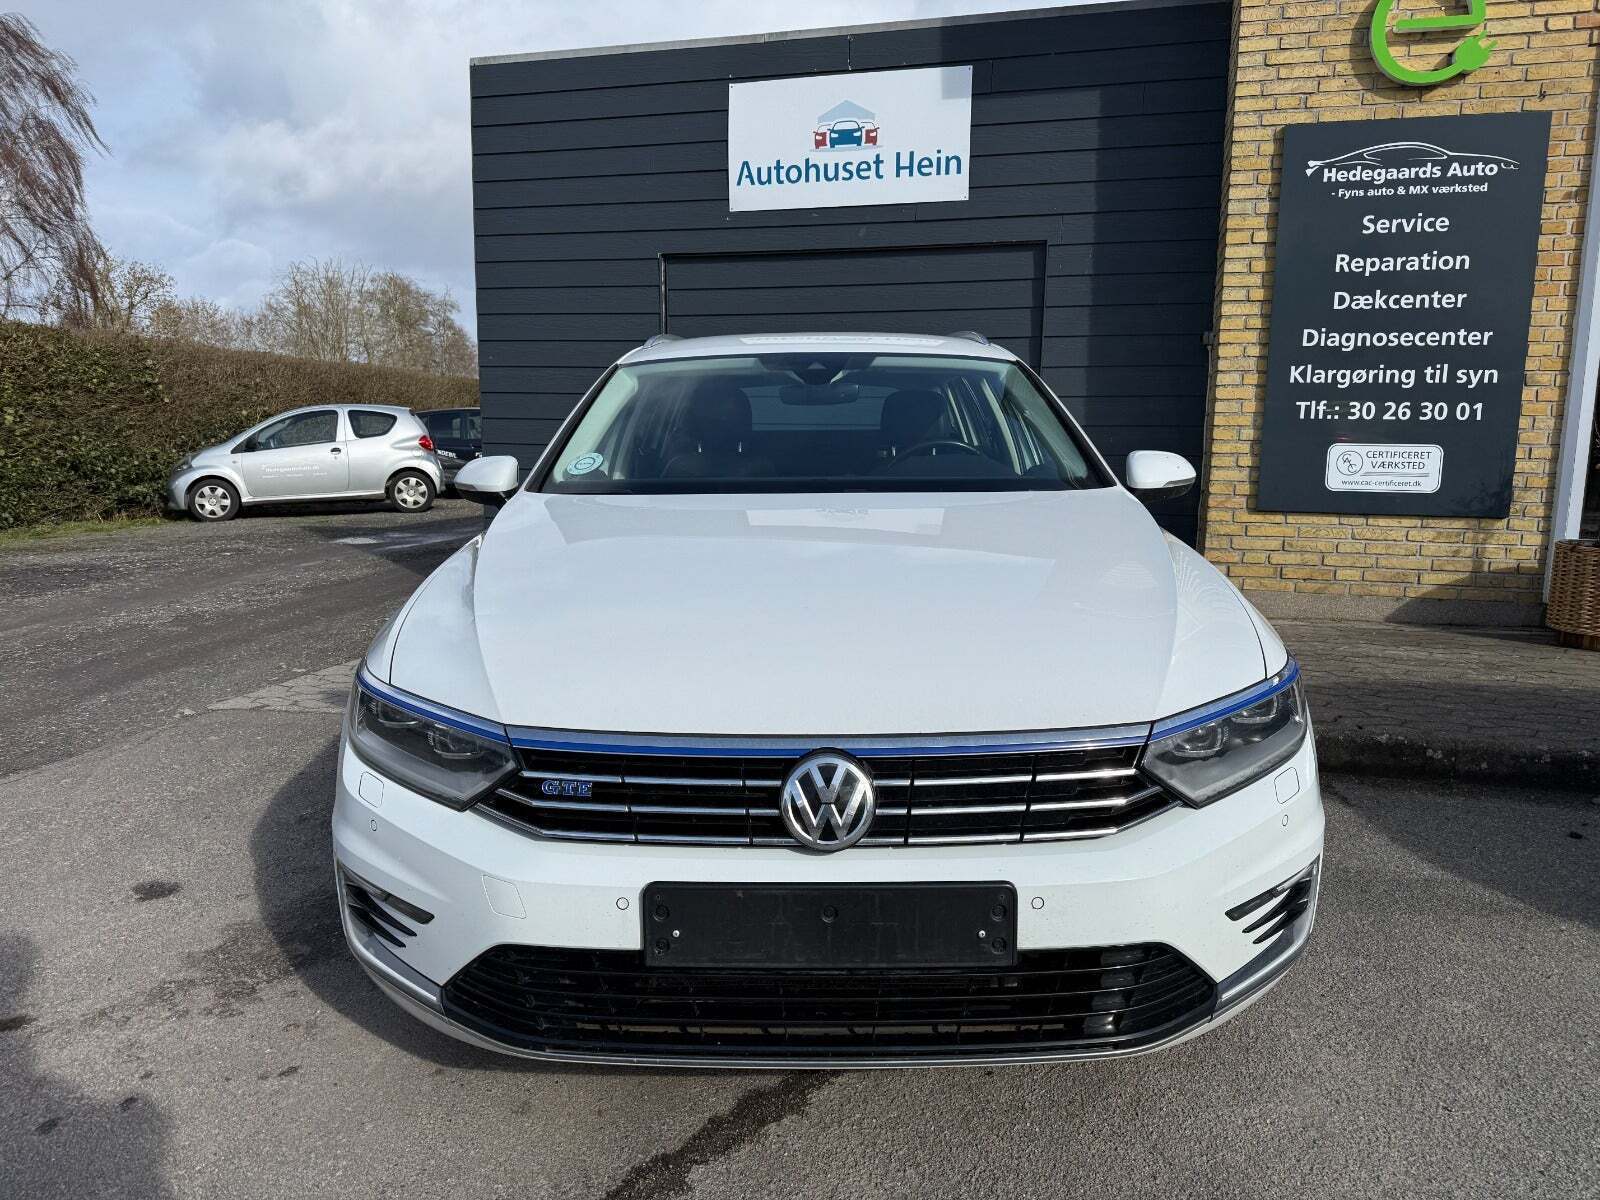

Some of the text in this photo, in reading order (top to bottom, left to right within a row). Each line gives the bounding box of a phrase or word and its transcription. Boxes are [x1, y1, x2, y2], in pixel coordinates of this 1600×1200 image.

[736, 149, 962, 187] Autohuset Hein
[1322, 162, 1499, 185] Hedegaards Auto
[1338, 188, 1365, 200] Fyns
[1367, 186, 1395, 197] auto
[1397, 186, 1406, 195] &
[1408, 184, 1430, 195] MX
[1431, 182, 1489, 195] værksted
[1362, 213, 1450, 234] Service
[1335, 250, 1471, 276] Reparation
[1333, 290, 1468, 310] Dækcenter
[1302, 327, 1494, 351] Diagnosecenter
[1289, 363, 1498, 388] Klargøring til syn
[1296, 401, 1483, 421] Tlf.: 30 26 30 01
[1366, 450, 1432, 460] CERTIFICERET
[1370, 461, 1426, 470] VÆRKSTED
[1341, 479, 1422, 487] www.cac-certificeret.dk
[541, 780, 593, 797] GTE
